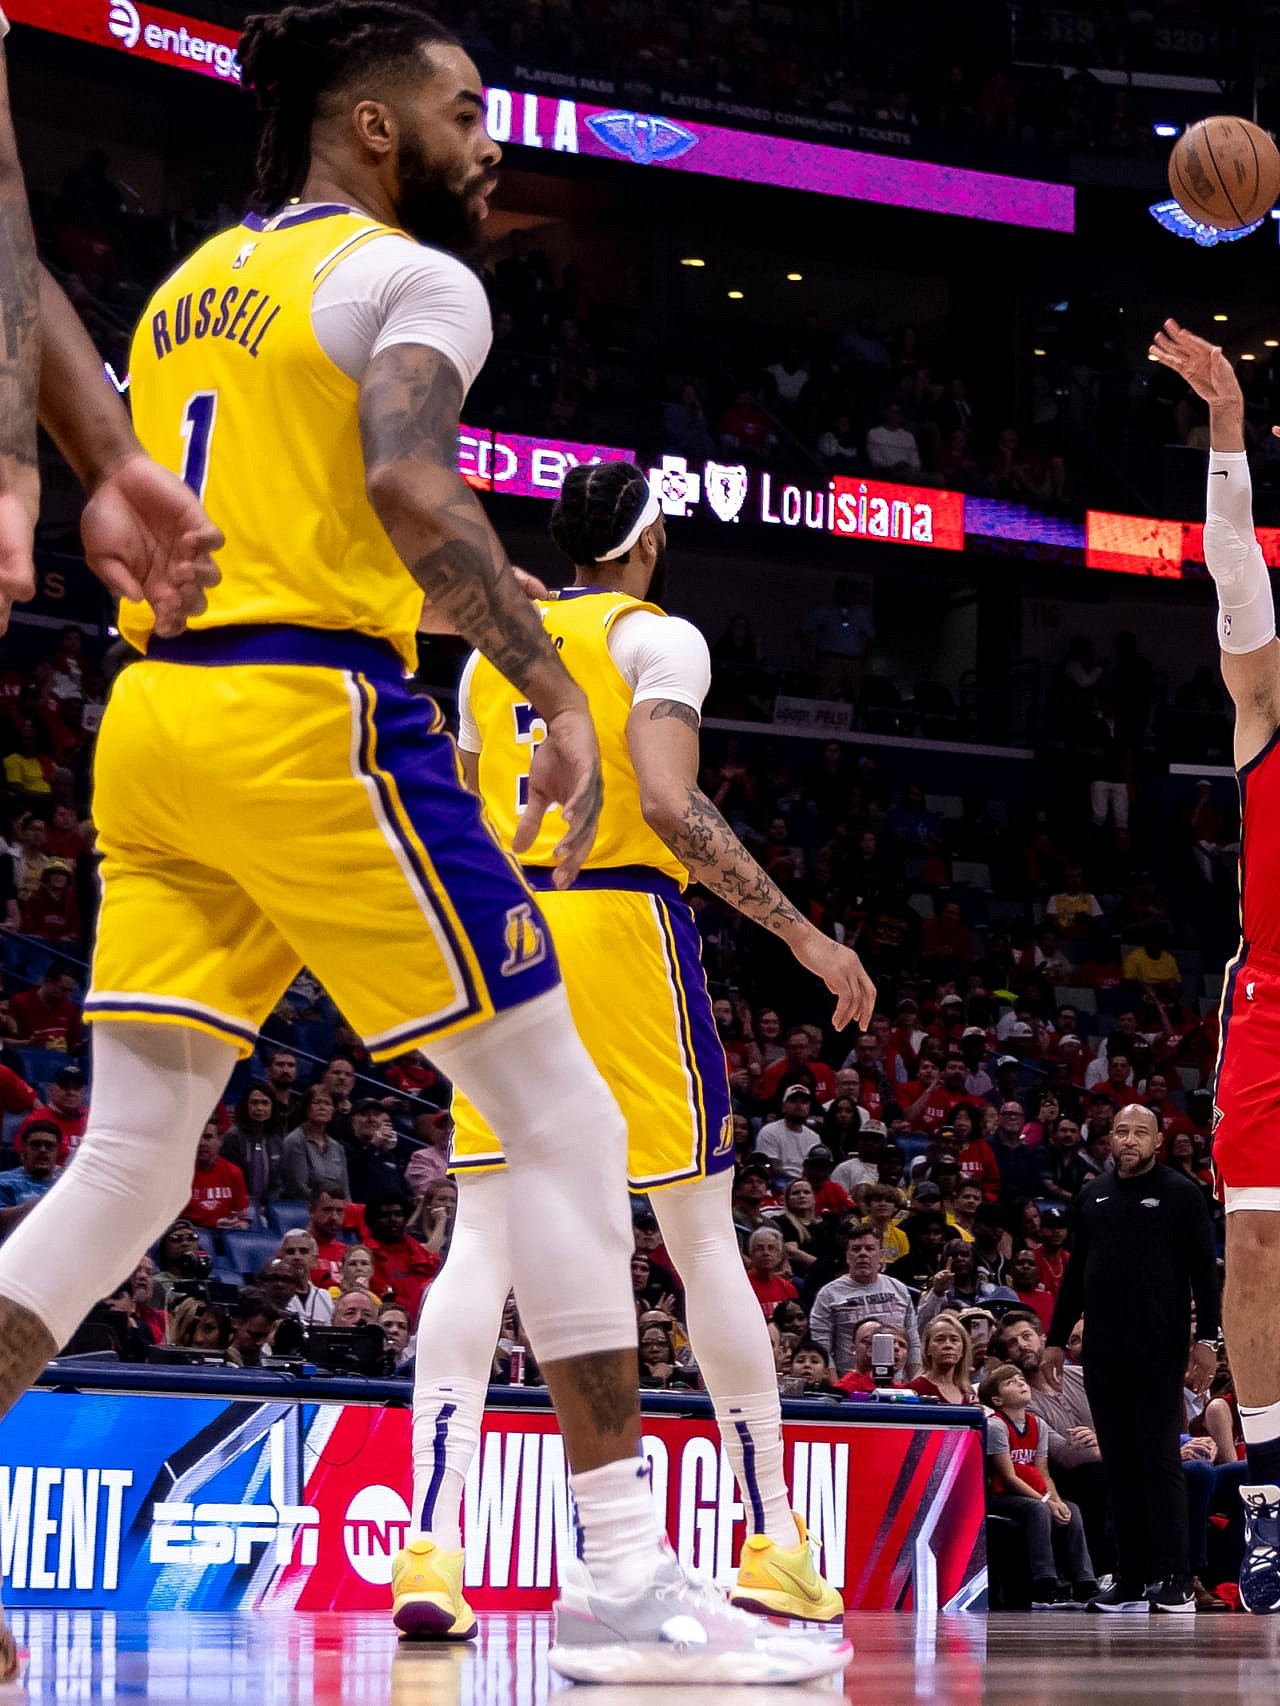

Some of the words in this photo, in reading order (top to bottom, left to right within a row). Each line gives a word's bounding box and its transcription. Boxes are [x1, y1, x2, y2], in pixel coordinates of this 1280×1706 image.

[152, 286, 281, 360] RUSSELL
[179, 388, 218, 504] 1
[762, 473, 933, 543] Louisiana
[149, 1502, 321, 1566] ESPN
